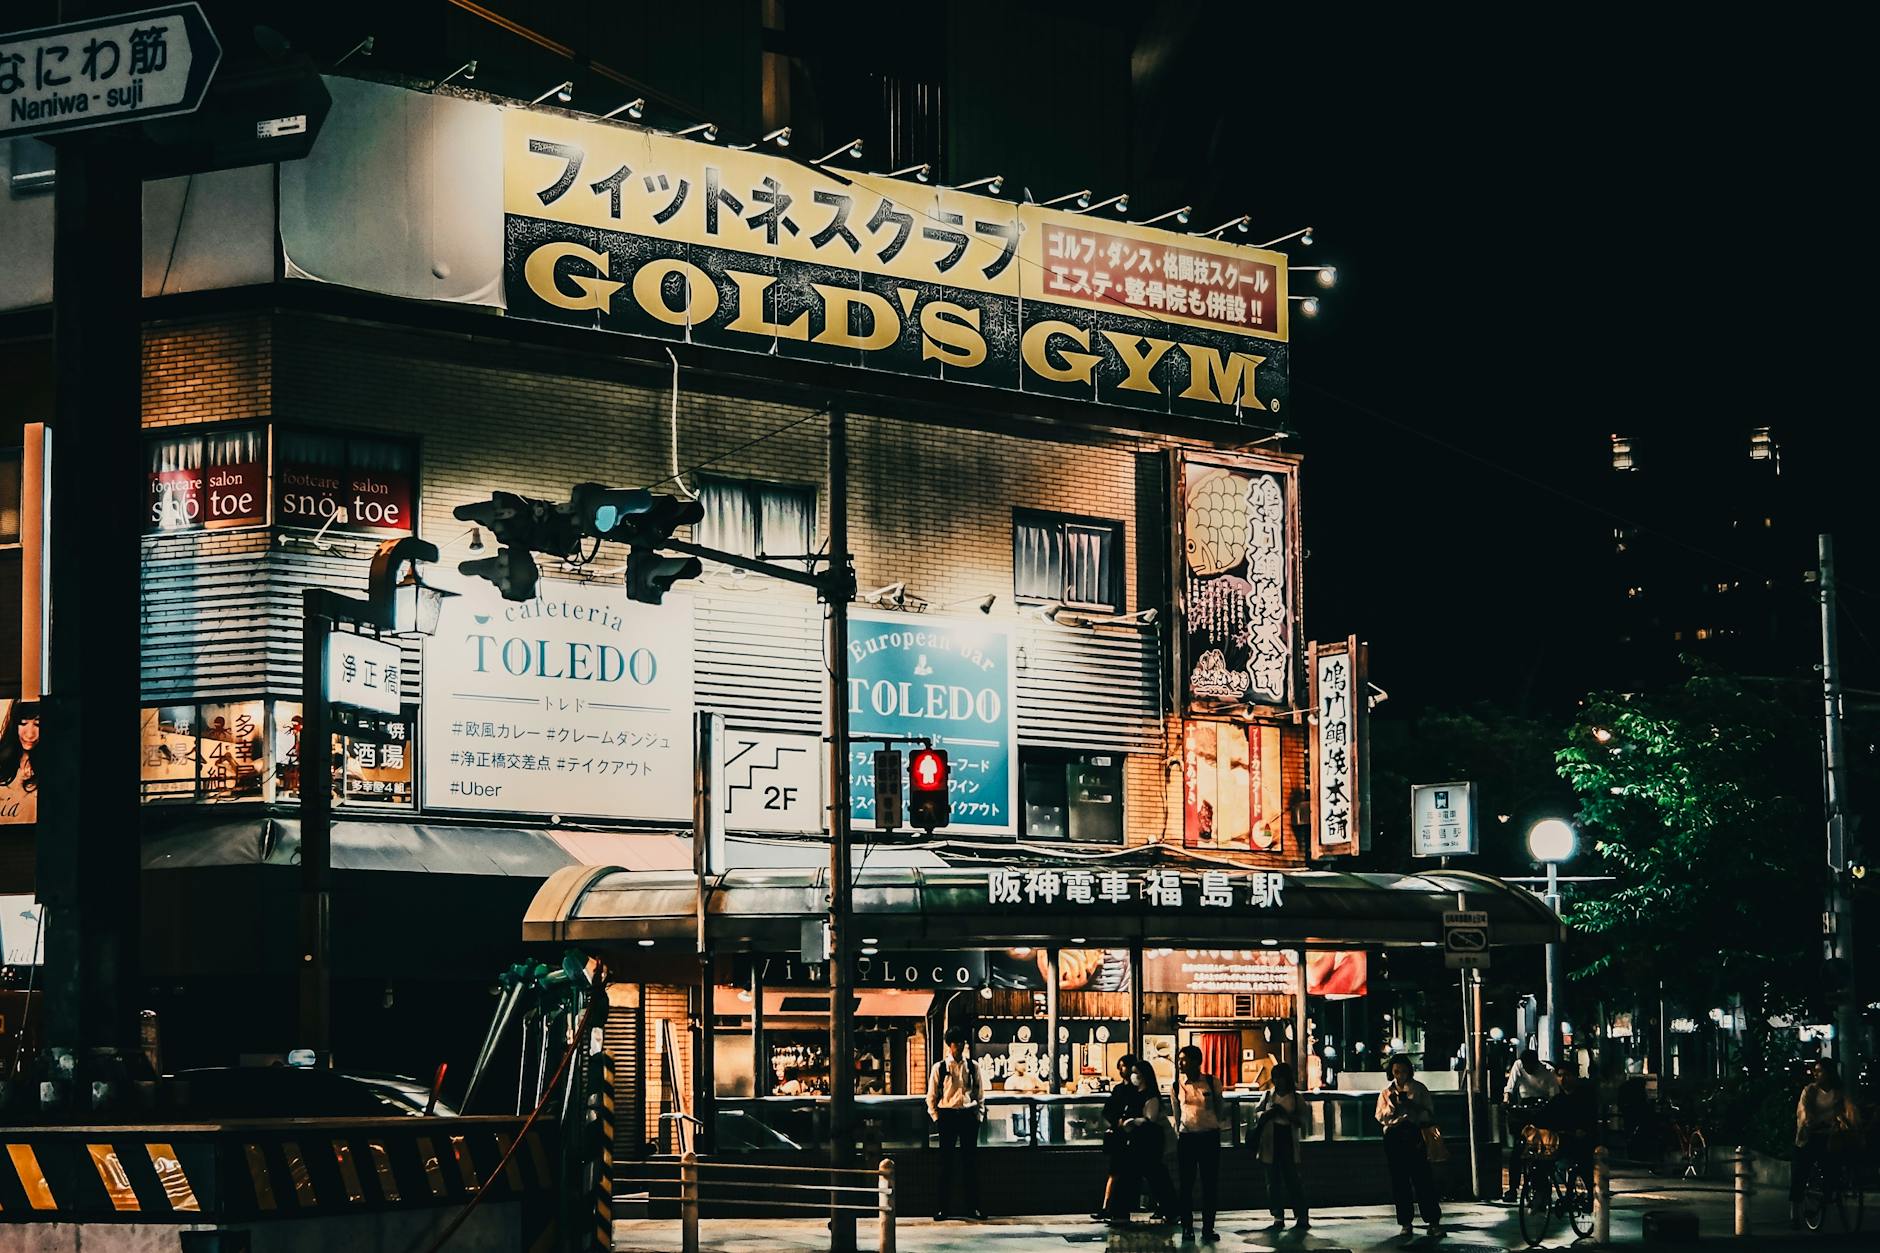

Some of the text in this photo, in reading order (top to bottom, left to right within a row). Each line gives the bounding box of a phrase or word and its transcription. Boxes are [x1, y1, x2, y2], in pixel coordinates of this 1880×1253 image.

[528, 138, 1026, 281] フィットネスクラブ
[1048, 231, 1269, 294] ゴルフ・ダンス・格闘技スクール
[524, 241, 987, 368] GOLD'S
[151, 471, 243, 494] footcare salon
[282, 470, 389, 494] footcare salon
[211, 491, 253, 516] toe
[283, 492, 400, 525] snö toe
[505, 598, 624, 632] cafeteria
[465, 634, 658, 686] TOLEDO
[848, 631, 950, 664] European
[545, 696, 586, 713] トレド
[848, 677, 1000, 724] TOLEDO
[452, 721, 541, 740] #欧風カレー
[353, 743, 405, 770] 酒場
[450, 750, 652, 777] #浄正橋交差点 #テイクアウト
[450, 781, 502, 798] #Uber
[763, 786, 798, 811] 2F
